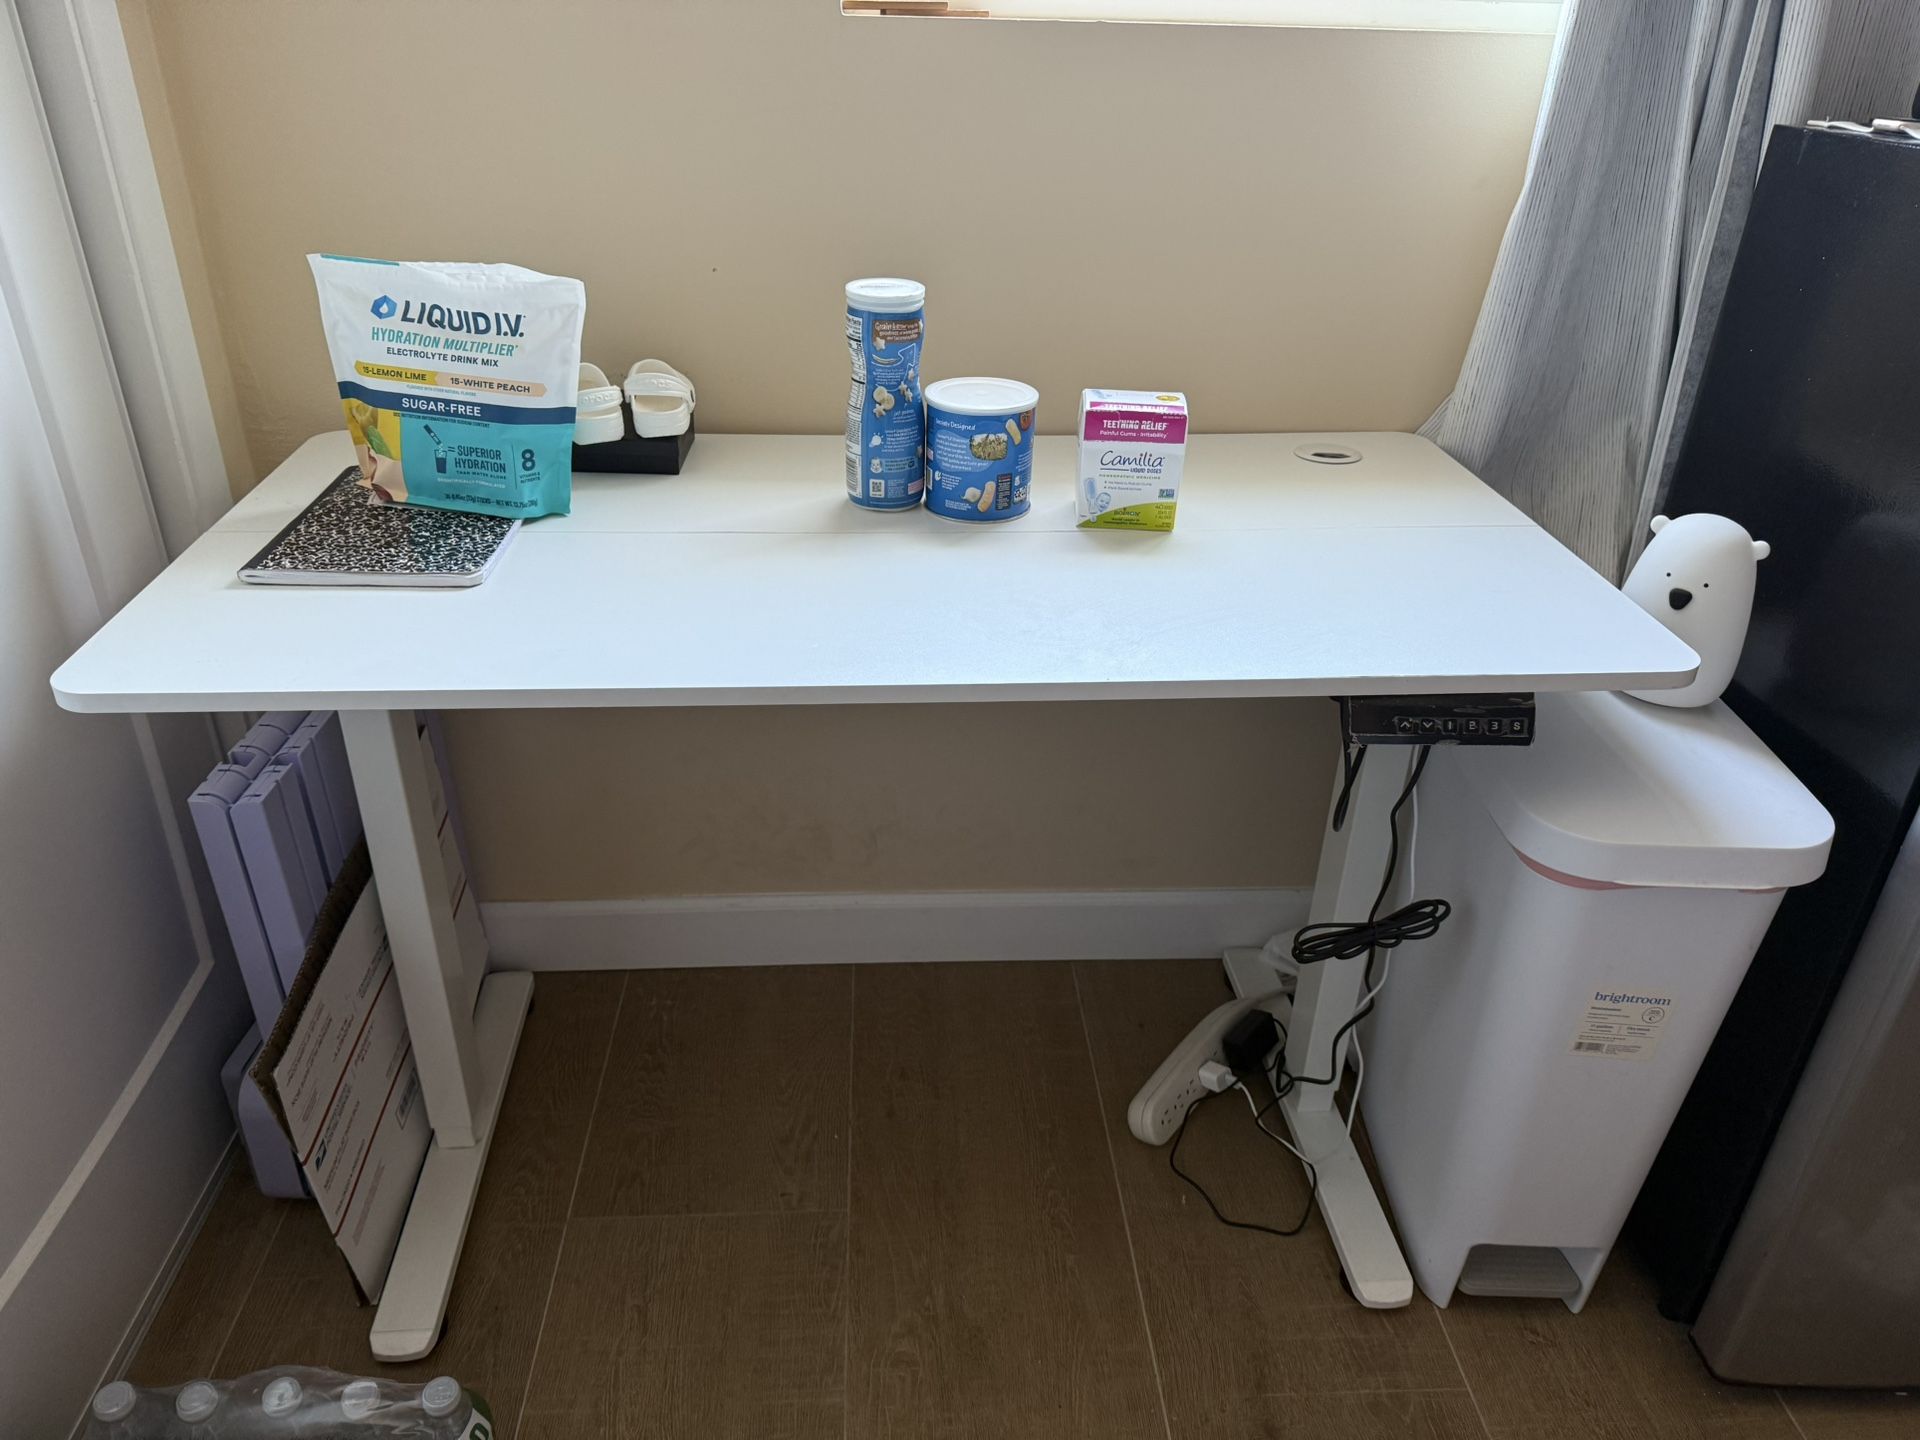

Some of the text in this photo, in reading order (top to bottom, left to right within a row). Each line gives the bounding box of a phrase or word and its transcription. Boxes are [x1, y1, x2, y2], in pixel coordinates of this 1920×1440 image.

[401, 300, 525, 338] LIQUID I.V.
[371, 326, 516, 356] HYDRATION MULTIPLIER
[386, 347, 499, 367] ELECTROLYTE DRINK MIX
[362, 366, 427, 381] 15-LEMON LIME
[450, 378, 530, 393] 15-WHITE PEACH
[401, 398, 482, 417] SUGAR-FREE
[951, 422, 976, 432] Designed
[1103, 420, 1167, 430] TEETHING RELIEF
[458, 445, 502, 460] SUPERIOR
[522, 448, 536, 472] 8
[1100, 450, 1164, 468] Camilia
[454, 458, 506, 473] HYDRATION
[1448, 722, 1452, 730] 1
[1469, 722, 1476, 730] 2
[1491, 722, 1498, 730] 3
[1594, 991, 1672, 1006] brightroom
